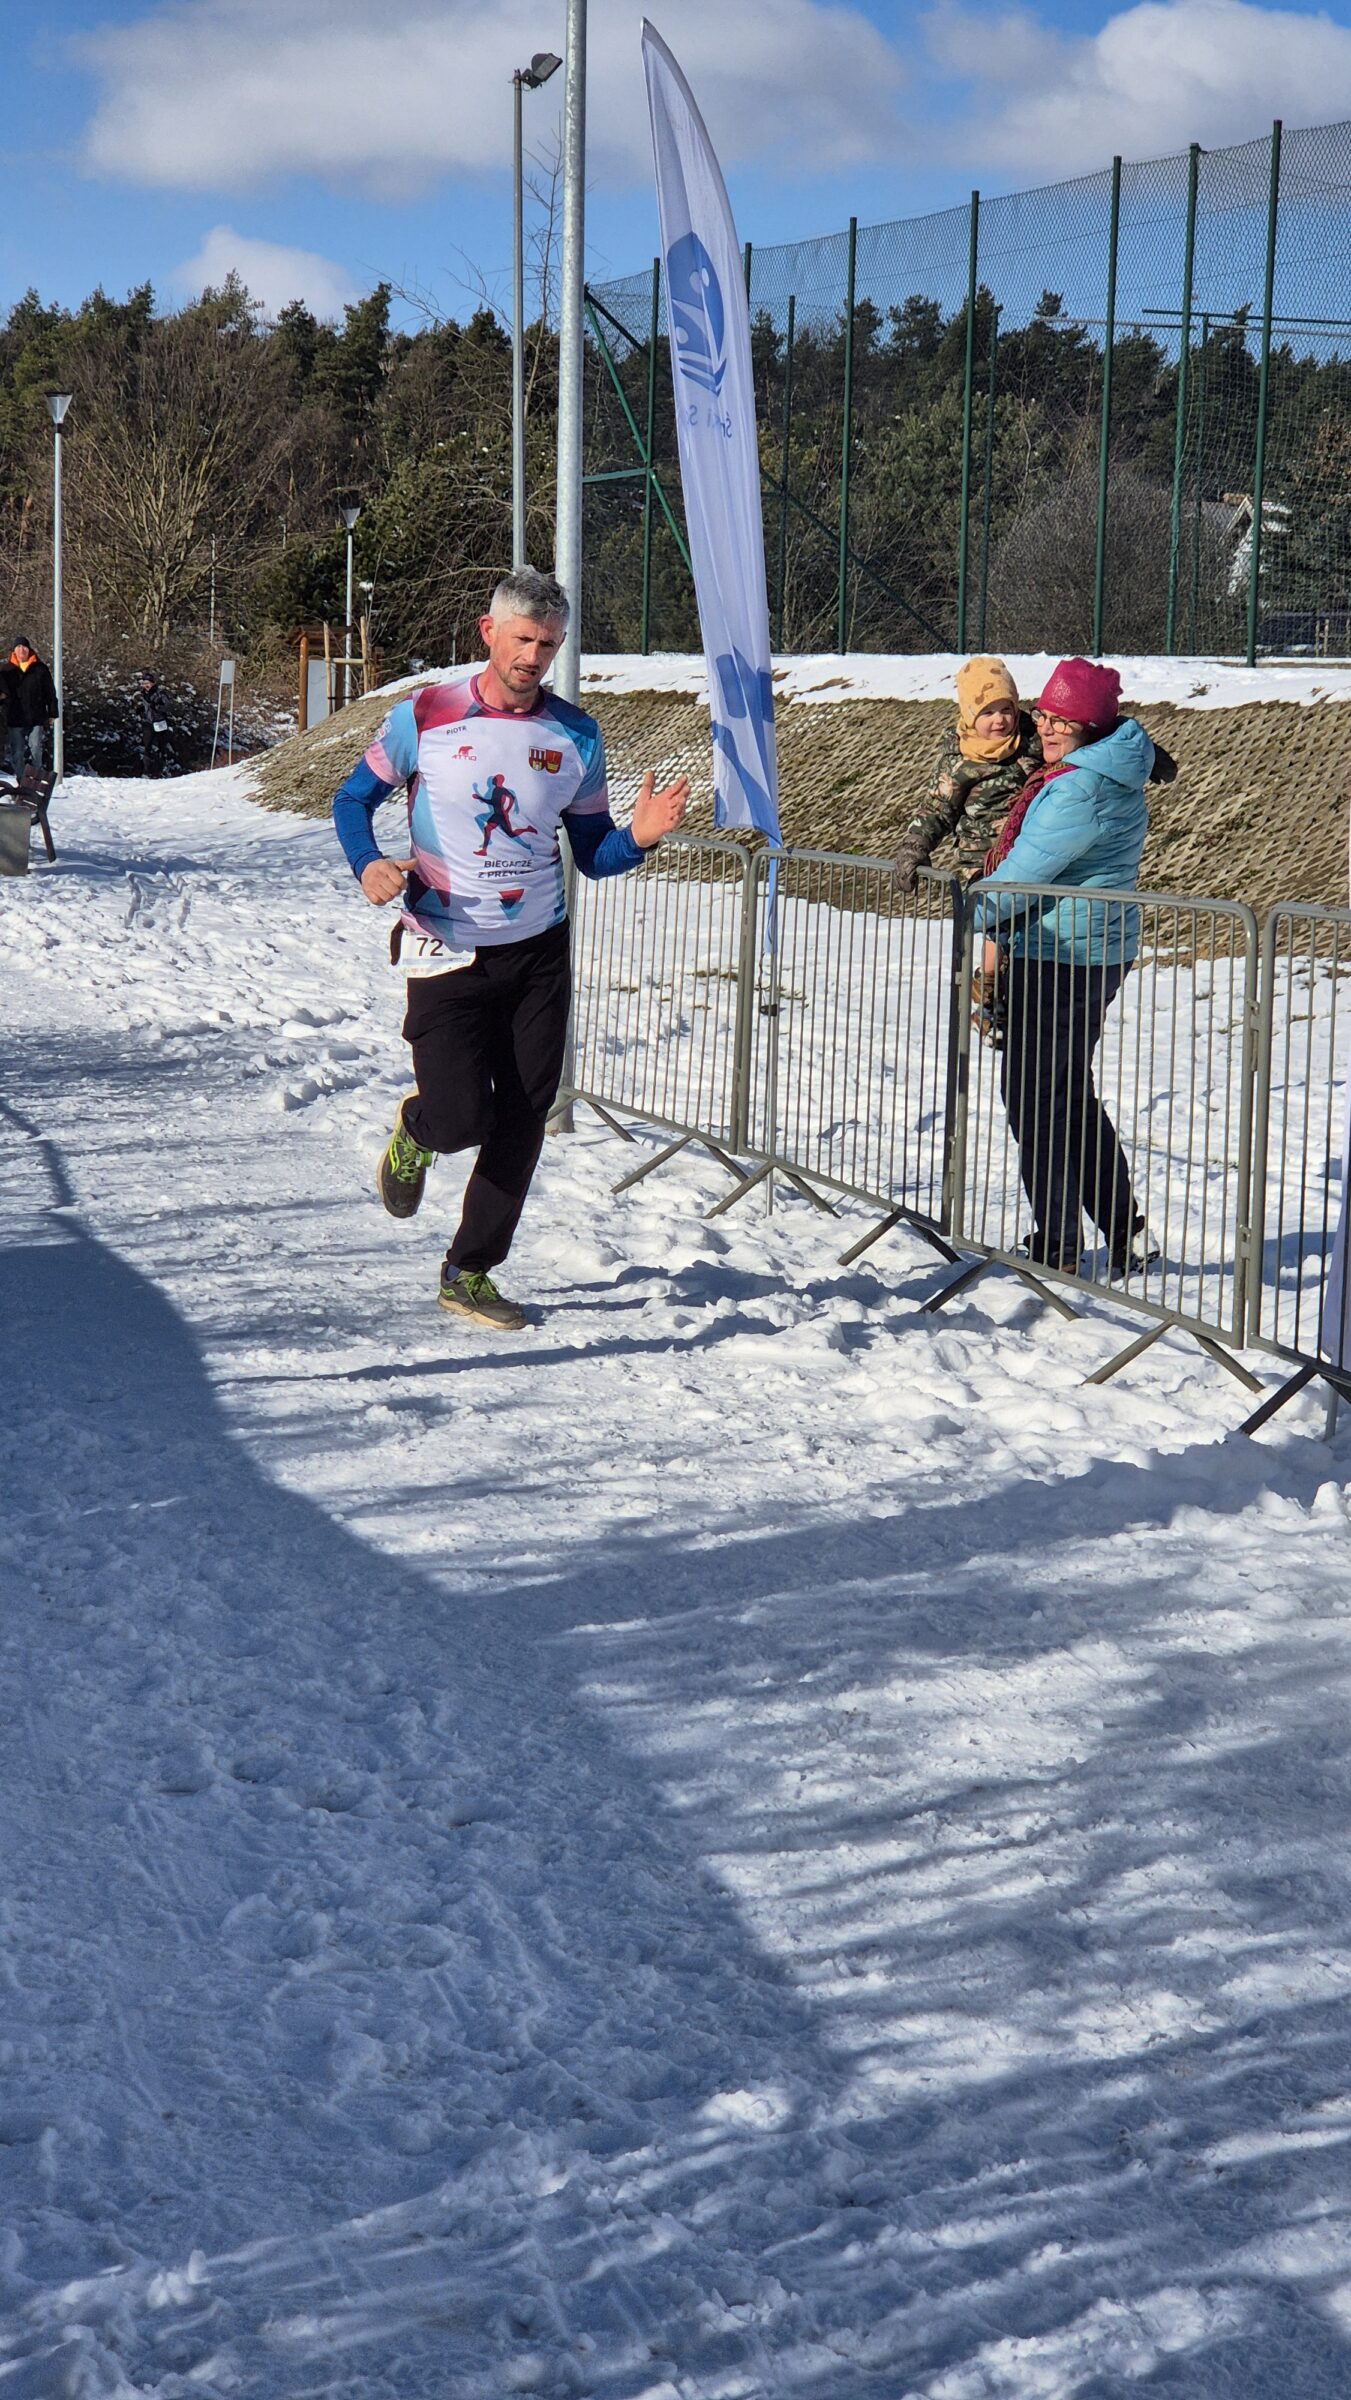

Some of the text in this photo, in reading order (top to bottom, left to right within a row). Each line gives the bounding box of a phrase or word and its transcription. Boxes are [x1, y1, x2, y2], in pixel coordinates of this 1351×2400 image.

[446, 725, 467, 735] PIOTR
[484, 859, 533, 868] BIEGACZE
[416, 937, 444, 957] 72
